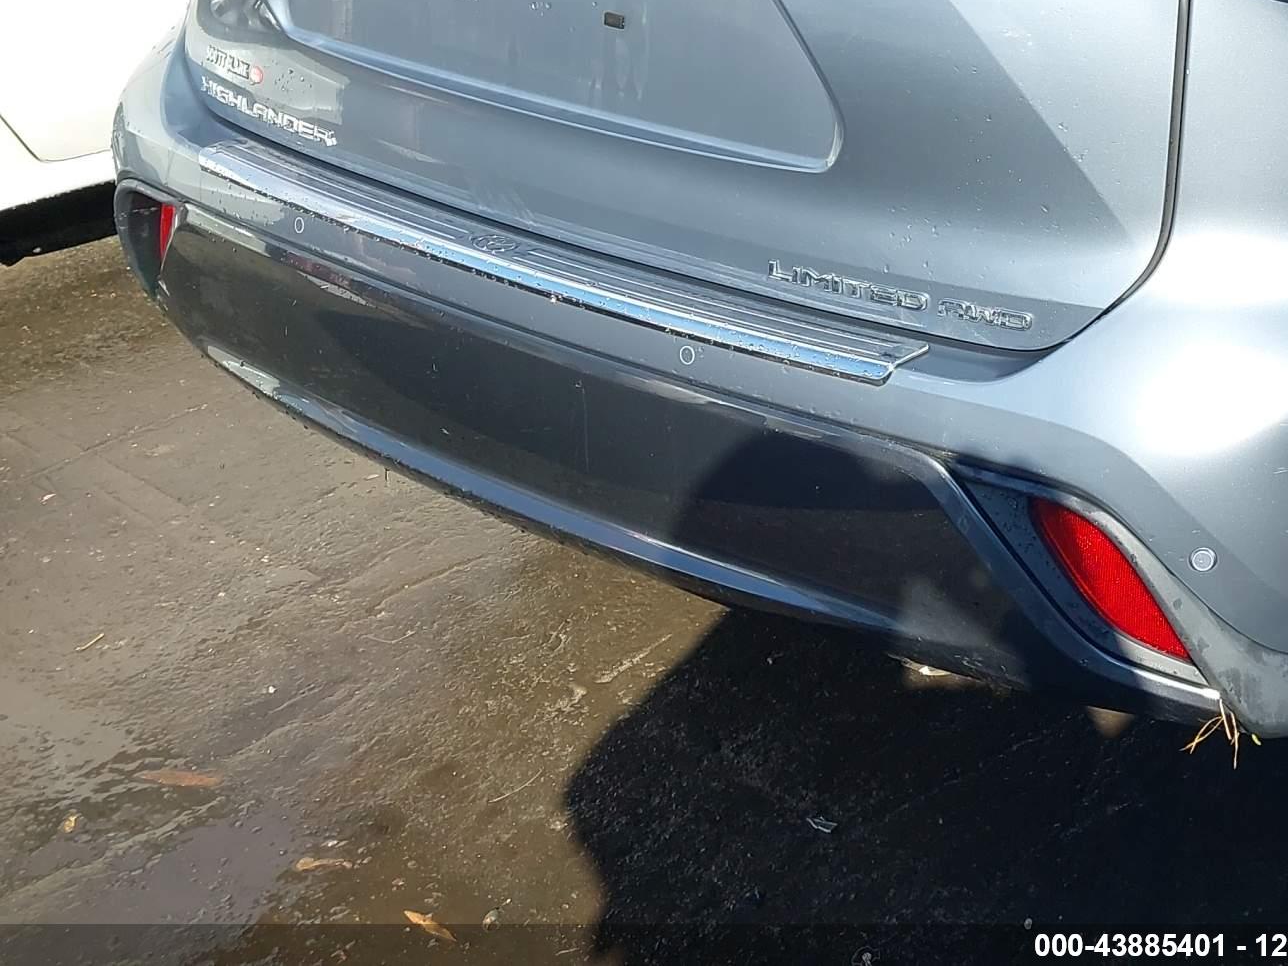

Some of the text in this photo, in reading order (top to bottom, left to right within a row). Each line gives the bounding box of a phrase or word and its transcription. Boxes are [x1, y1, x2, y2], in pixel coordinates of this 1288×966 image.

[200, 76, 337, 146] HIGHLANDER
[767, 259, 1034, 331] LIMITED AWD
